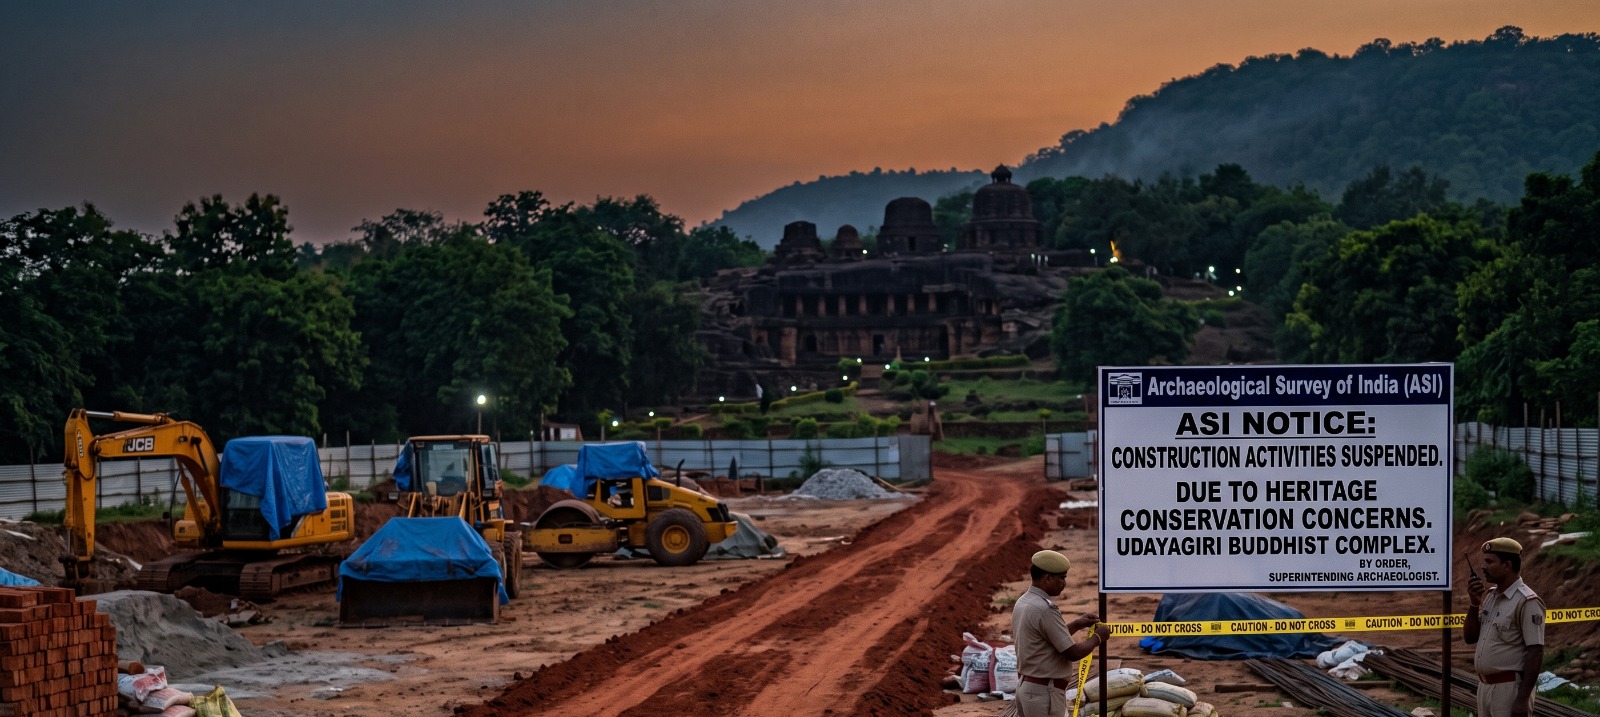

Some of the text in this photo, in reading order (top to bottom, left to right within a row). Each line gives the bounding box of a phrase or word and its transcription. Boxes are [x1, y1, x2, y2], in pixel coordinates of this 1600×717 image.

[1147, 373, 1443, 401] Archaeological Survey of India (ASI)
[1175, 410, 1376, 436] ASI NOTICE:
[127, 436, 155, 452] JCB
[1111, 444, 1443, 469] CONSTRUCTION ACTIVITIES SUSPENDED.
[1176, 479, 1378, 503] DUE TO HERITAGE
[1120, 506, 1432, 531] CONSERVATION CONCERNS.
[1116, 534, 1436, 556] UDAYAGIRI BUDDHIST COMPLEX.
[1359, 558, 1411, 571] BY ORDER,
[1268, 571, 1440, 583] SUPERINTENDING ARCHAEOLOGIST.
[1365, 618, 1402, 628] CAUTION
[1410, 617, 1422, 627] DO
[1424, 617, 1441, 626] NOT
[1443, 615, 1466, 626] CROS
[1551, 611, 1564, 621] DO
[1565, 610, 1583, 620] NOT
[1584, 609, 1600, 619] CRO
[1107, 624, 1134, 634] UTION
[1141, 624, 1153, 633] DO
[1155, 624, 1173, 633] NOT
[1174, 623, 1202, 633] CROSS
[1231, 622, 1268, 632] CAUTION
[1275, 621, 1287, 631] DO
[1289, 620, 1307, 630] NOT
[1308, 620, 1336, 630] CROSS
